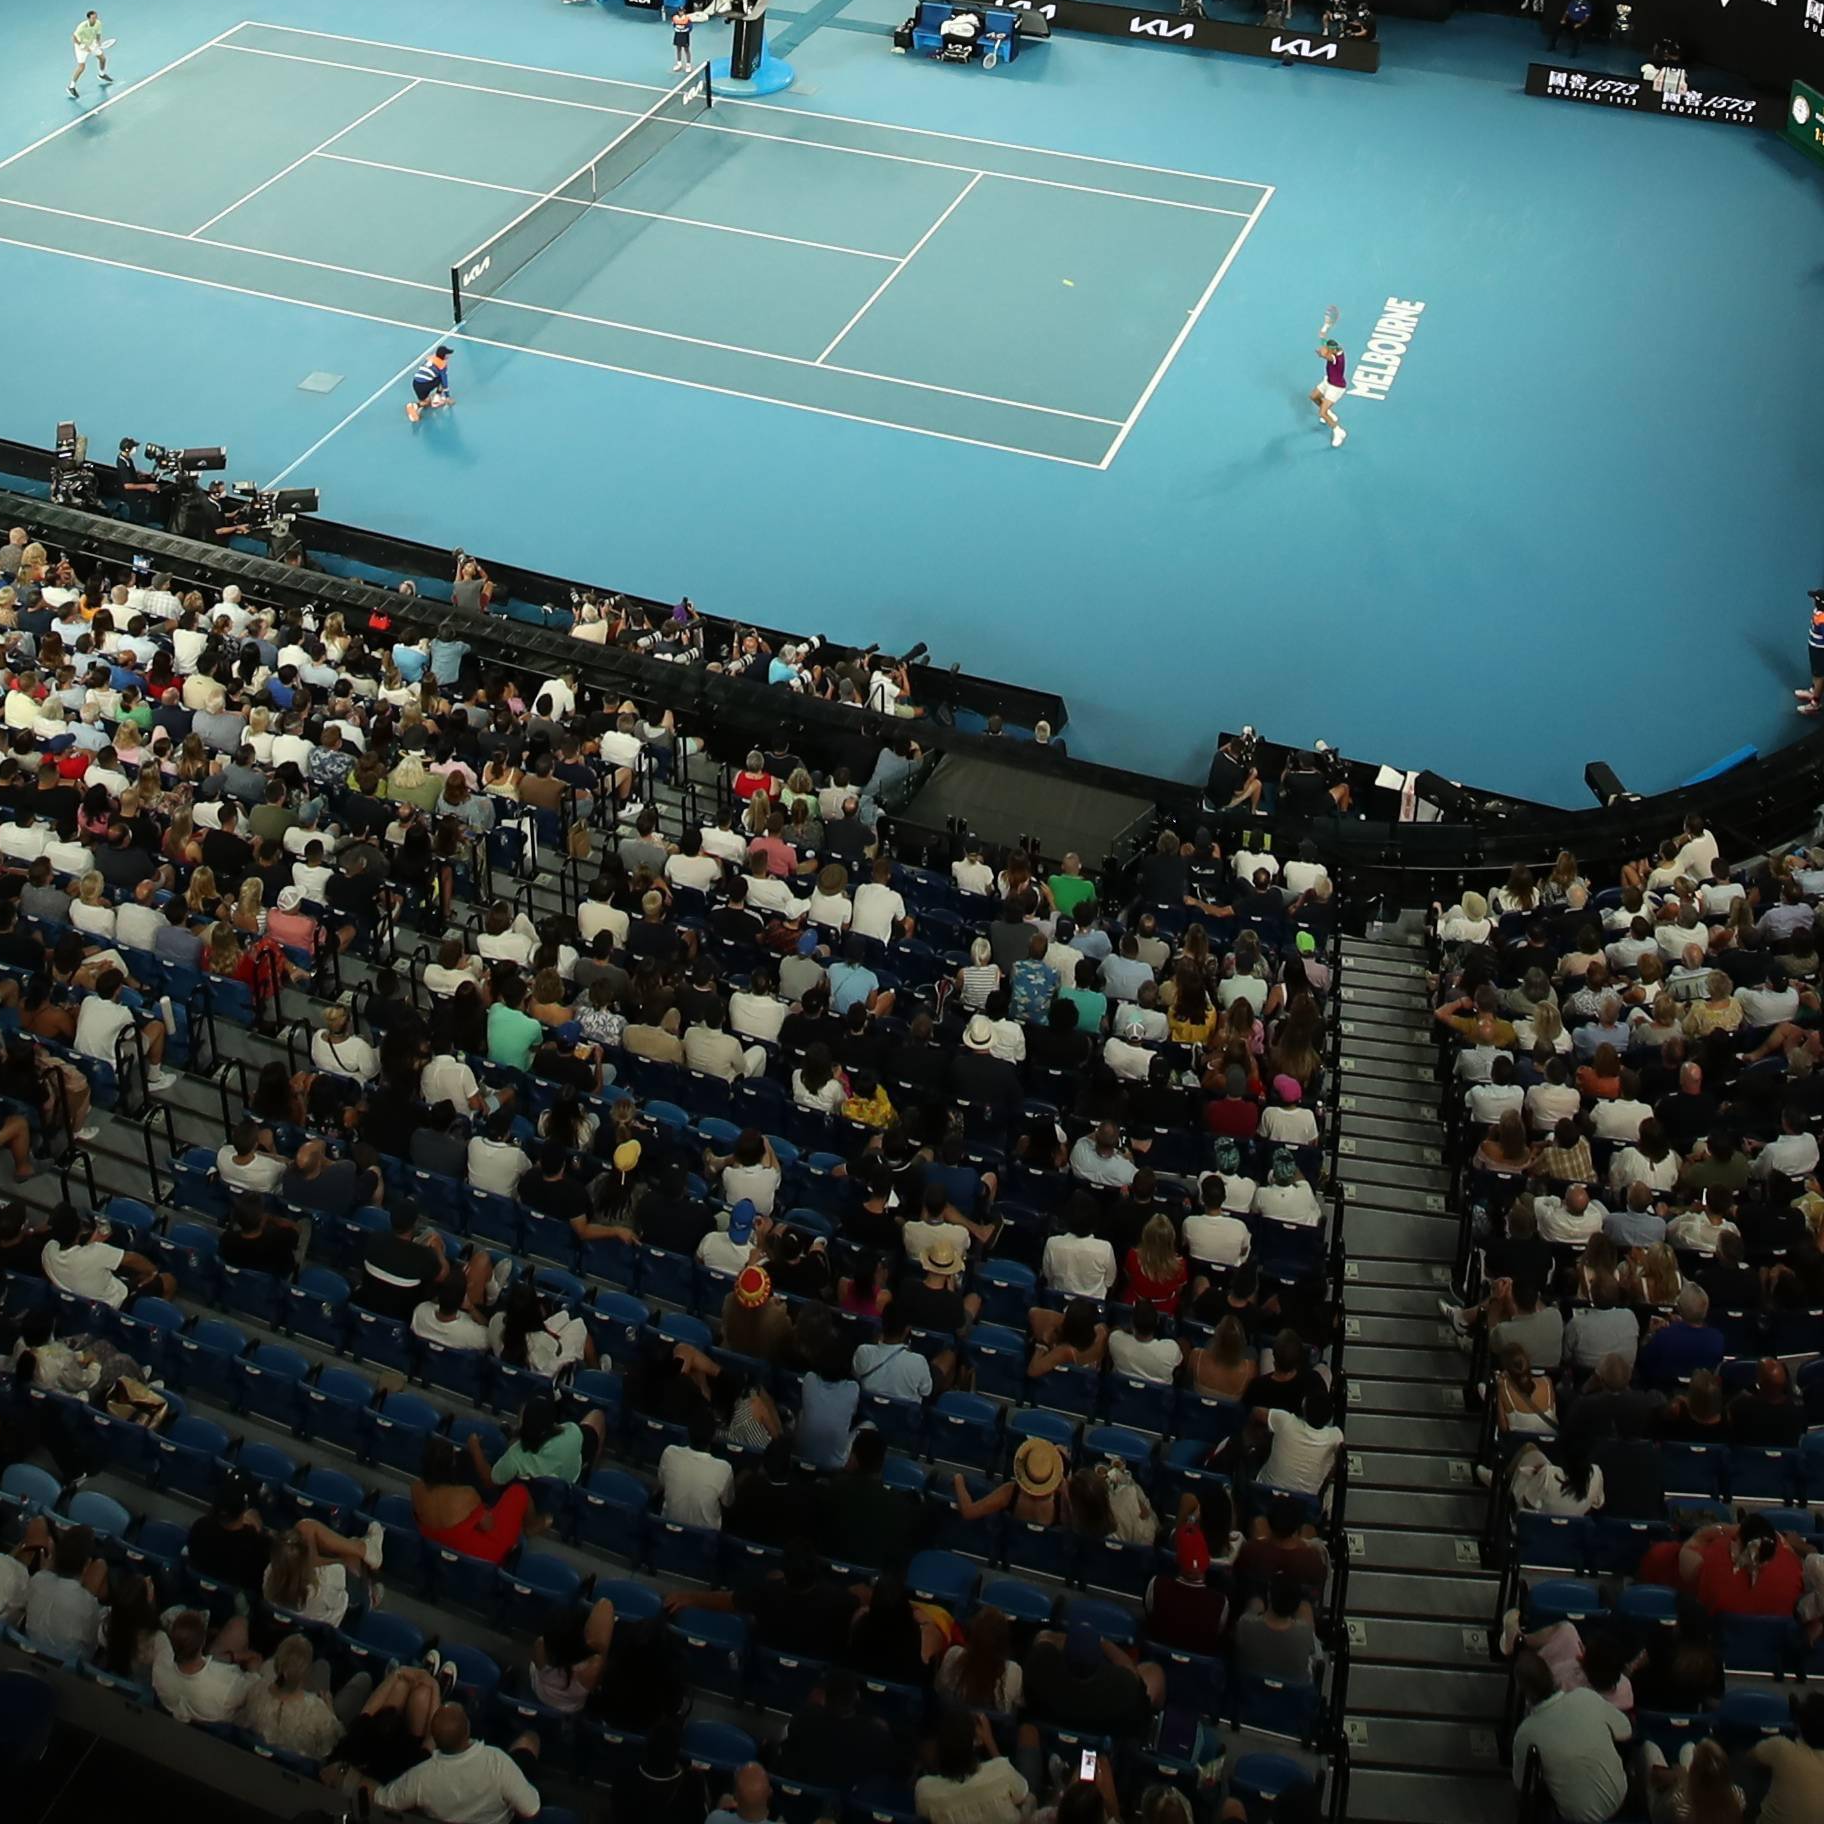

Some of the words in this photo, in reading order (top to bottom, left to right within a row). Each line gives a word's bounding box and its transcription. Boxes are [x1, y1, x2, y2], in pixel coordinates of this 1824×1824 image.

[1547, 87, 1601, 101] GUOJIAO
[1588, 79, 1640, 96] 1573
[1661, 103, 1716, 118] GUOJIAO
[1704, 95, 1757, 113] 1573
[1346, 296, 1426, 401] MELBOURNE
